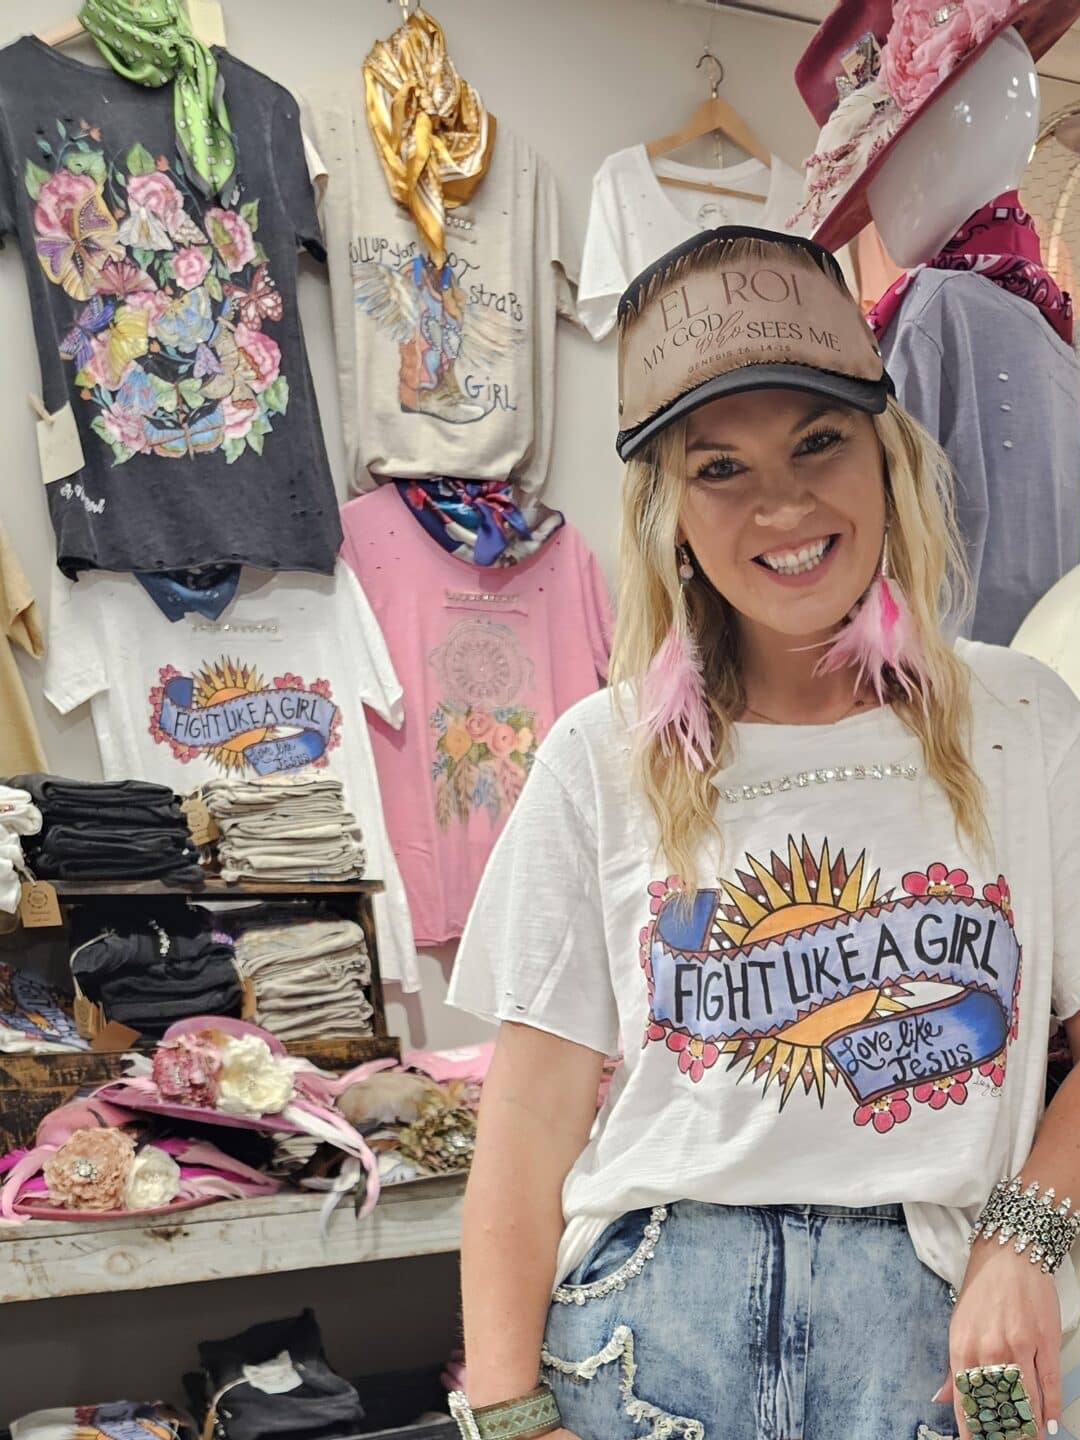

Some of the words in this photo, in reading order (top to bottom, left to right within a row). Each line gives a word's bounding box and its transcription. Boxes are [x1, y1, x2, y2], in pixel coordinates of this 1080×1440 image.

[660, 286, 709, 332] EL
[721, 268, 803, 306] ROI
[673, 313, 724, 347] GOD
[695, 310, 745, 354] who
[746, 321, 803, 341] SEES
[809, 326, 842, 352] ME
[641, 338, 667, 375] MY
[687, 350, 733, 374] GENESIS
[174, 711, 222, 739] FIGHT
[223, 701, 260, 733] LIKE
[261, 698, 279, 723] A
[279, 695, 321, 724] GIRL
[674, 961, 776, 1024] FIGHT
[785, 933, 866, 1003] LIKE
[871, 923, 910, 983] A
[914, 913, 1000, 980] GIRL
[838, 1031, 893, 1077] Love
[896, 1015, 944, 1058] like
[887, 1043, 973, 1084] Jesus
